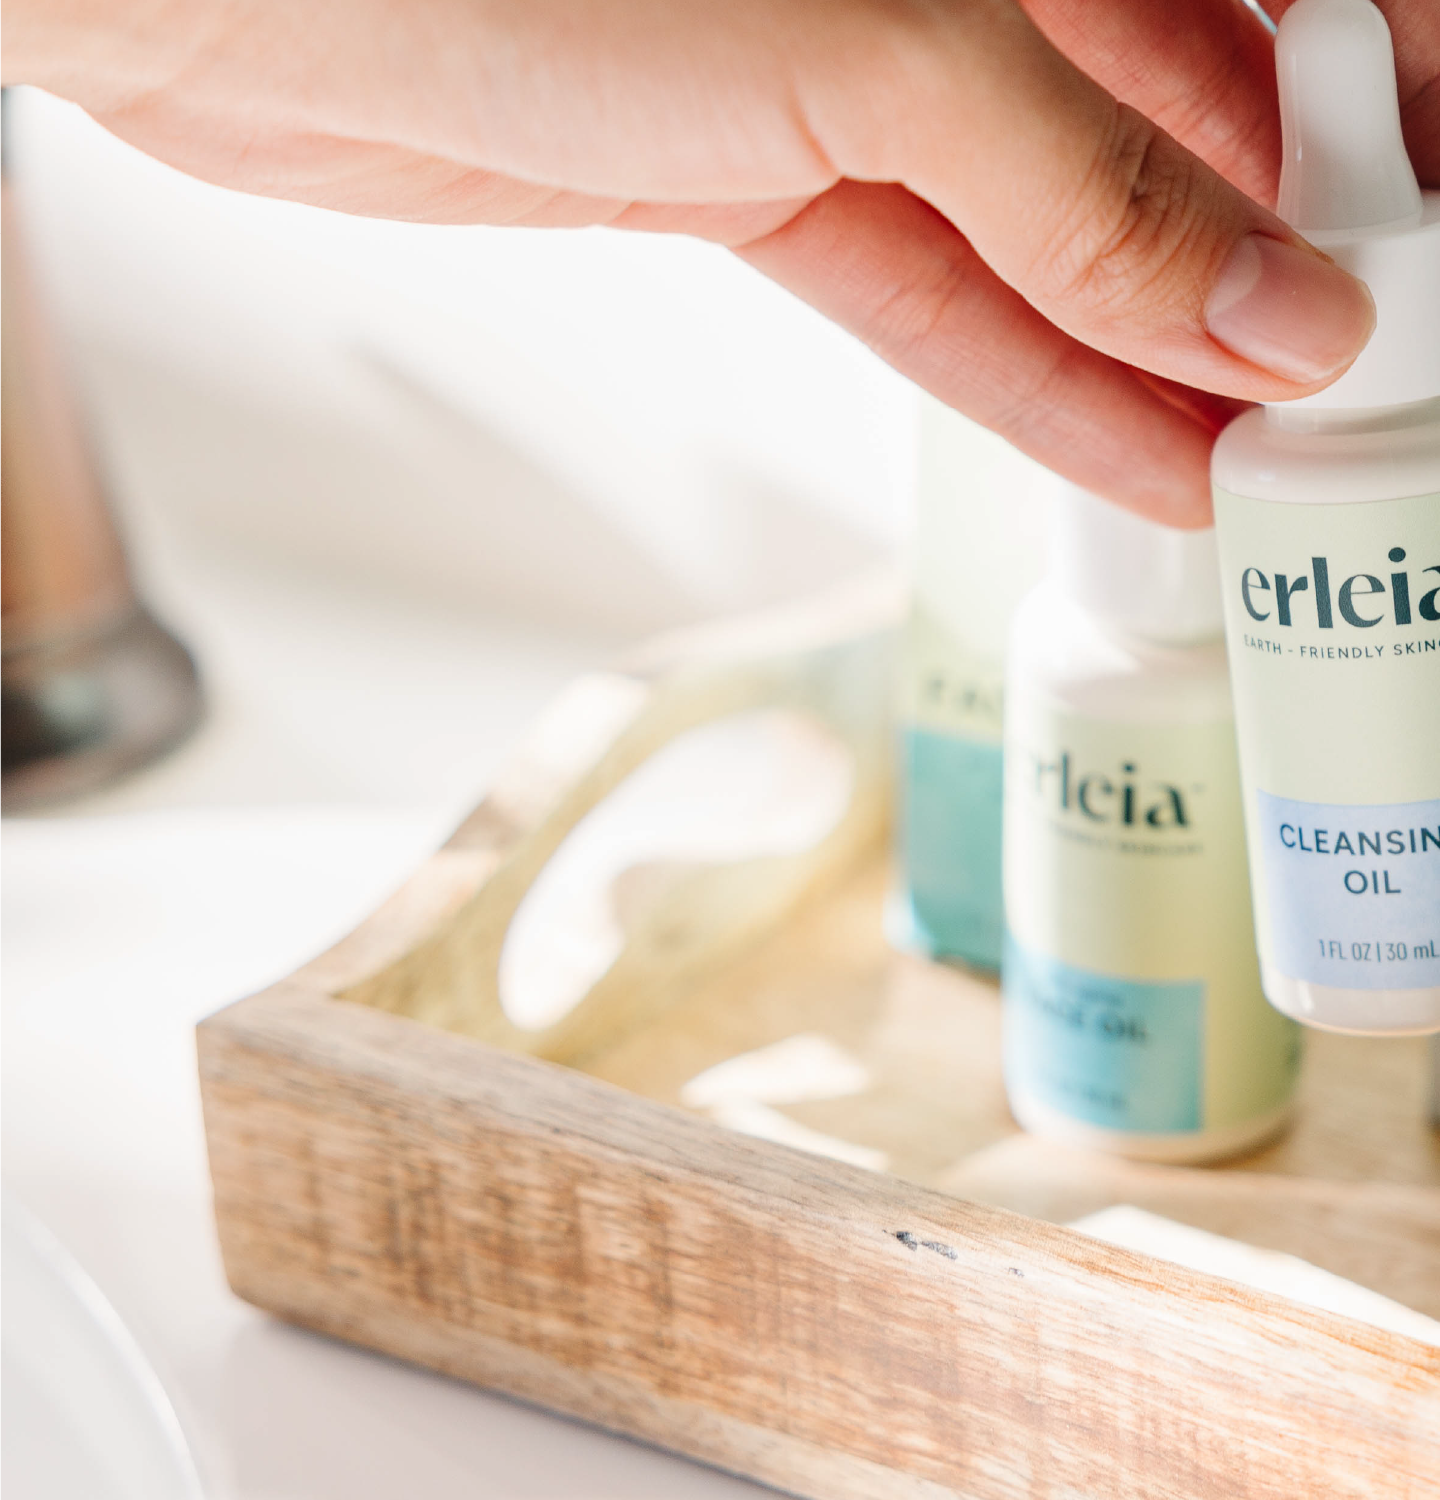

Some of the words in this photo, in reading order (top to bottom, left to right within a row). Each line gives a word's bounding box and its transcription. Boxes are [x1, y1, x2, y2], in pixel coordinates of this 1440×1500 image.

[1244, 634, 1283, 656] EARTH
[1299, 645, 1385, 660] FRIENDLY
[1034, 752, 1191, 829] rleia
[1343, 869, 1402, 895] OIL
[1328, 941, 1348, 960] FL
[1414, 939, 1440, 959] mL
